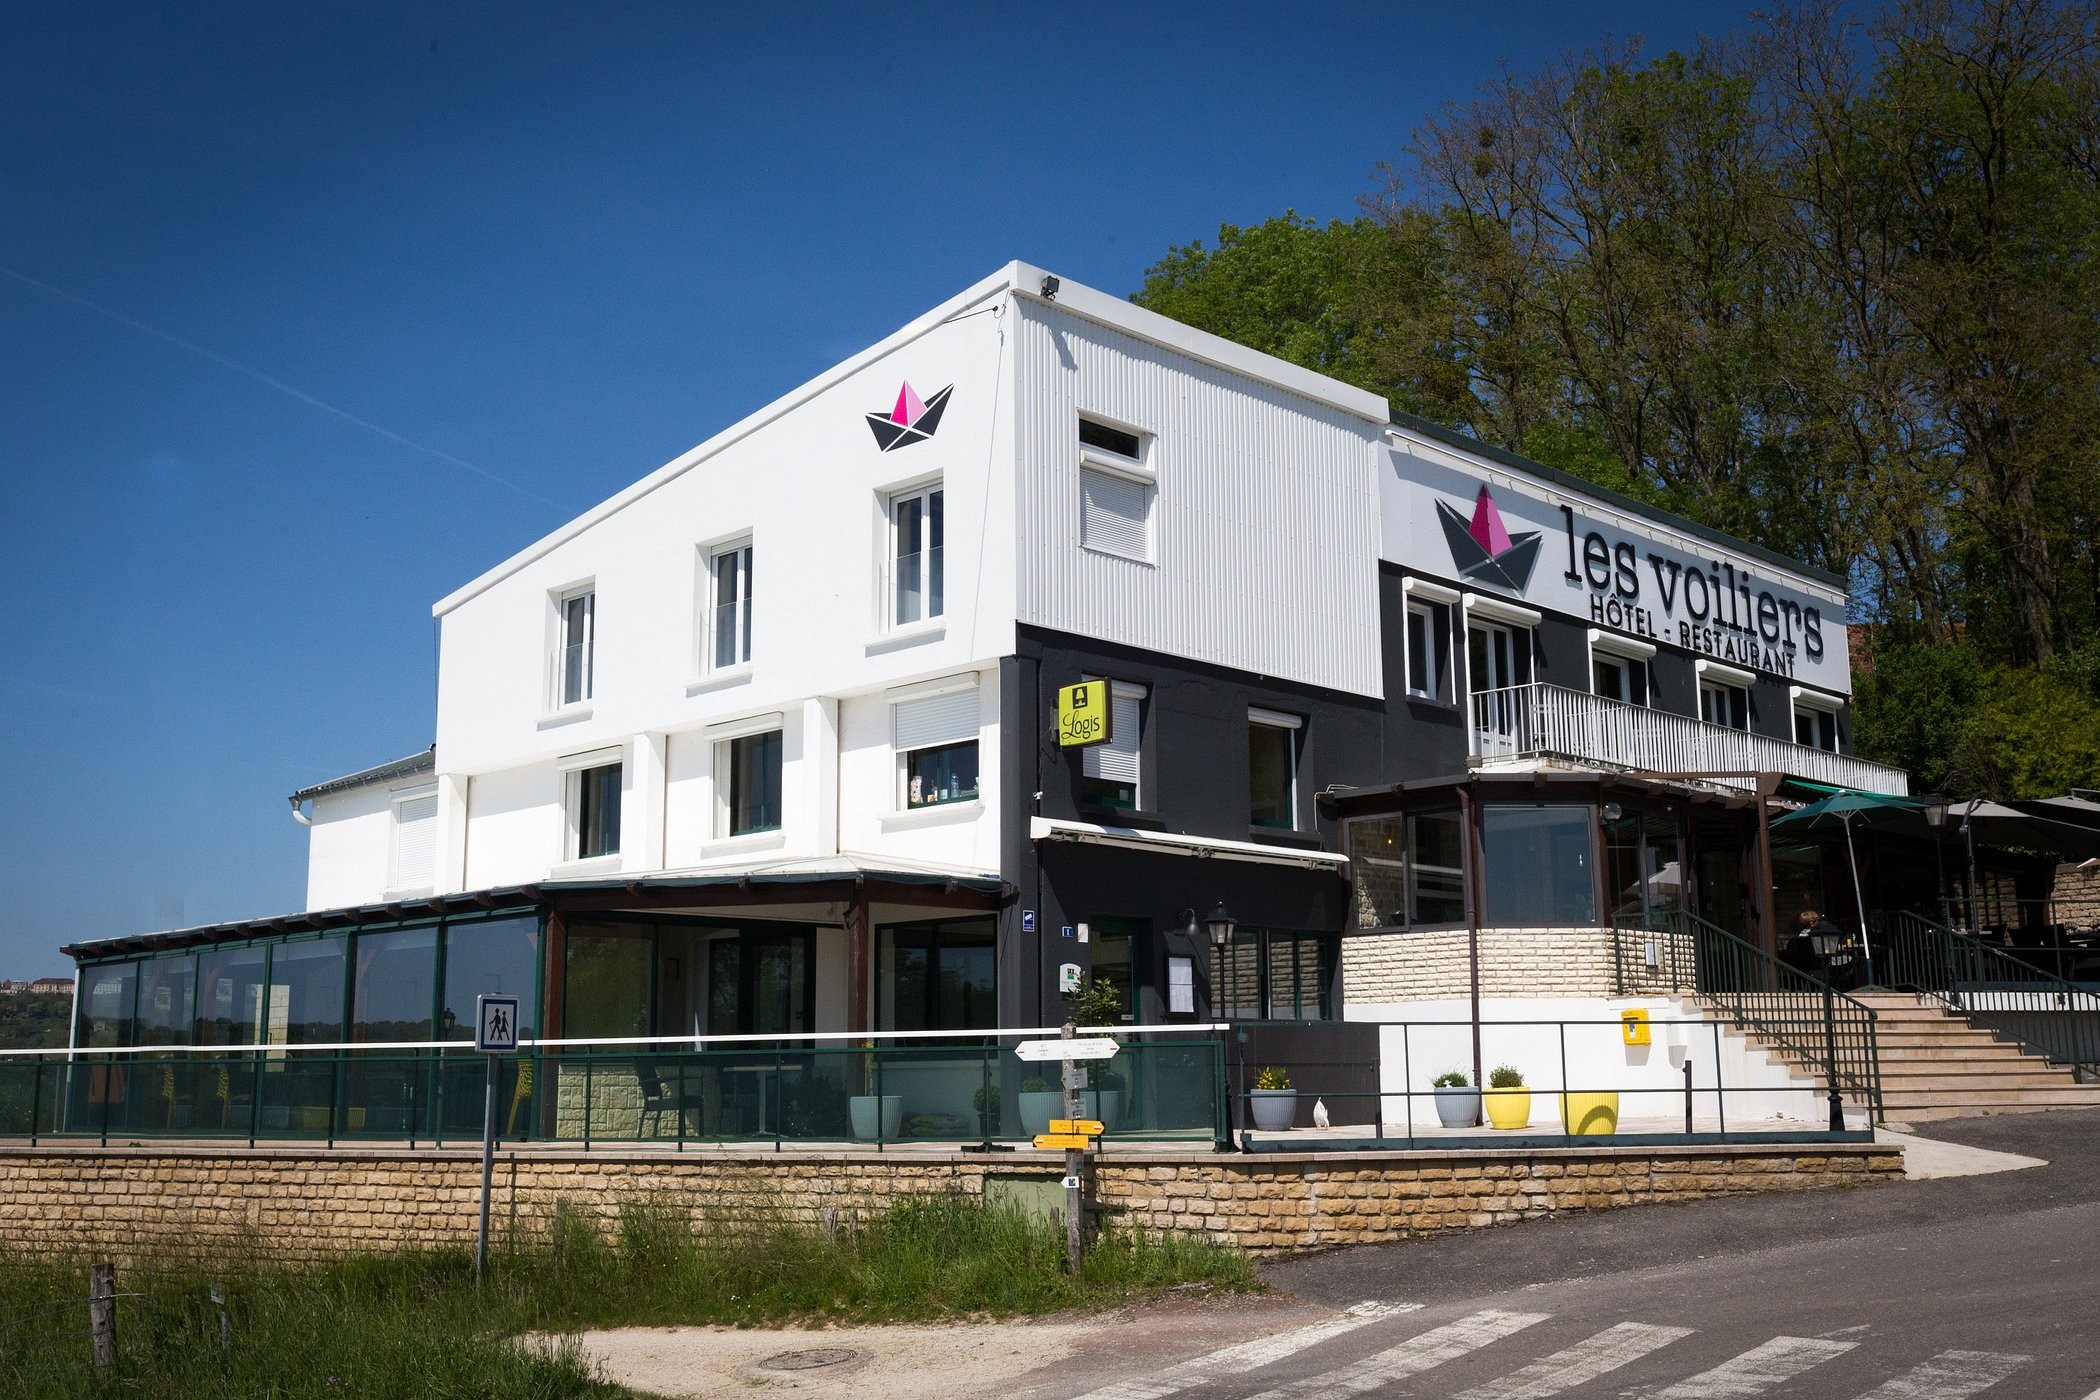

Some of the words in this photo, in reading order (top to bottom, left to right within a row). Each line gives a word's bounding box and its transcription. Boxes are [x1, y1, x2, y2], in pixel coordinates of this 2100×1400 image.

[1560, 504, 1640, 599] les
[1648, 553, 1824, 657] voiliers
[1590, 593, 1657, 638] HÔTEL
[1680, 621, 1795, 678] RESTAURANT
[1061, 710, 1100, 739] Logis
